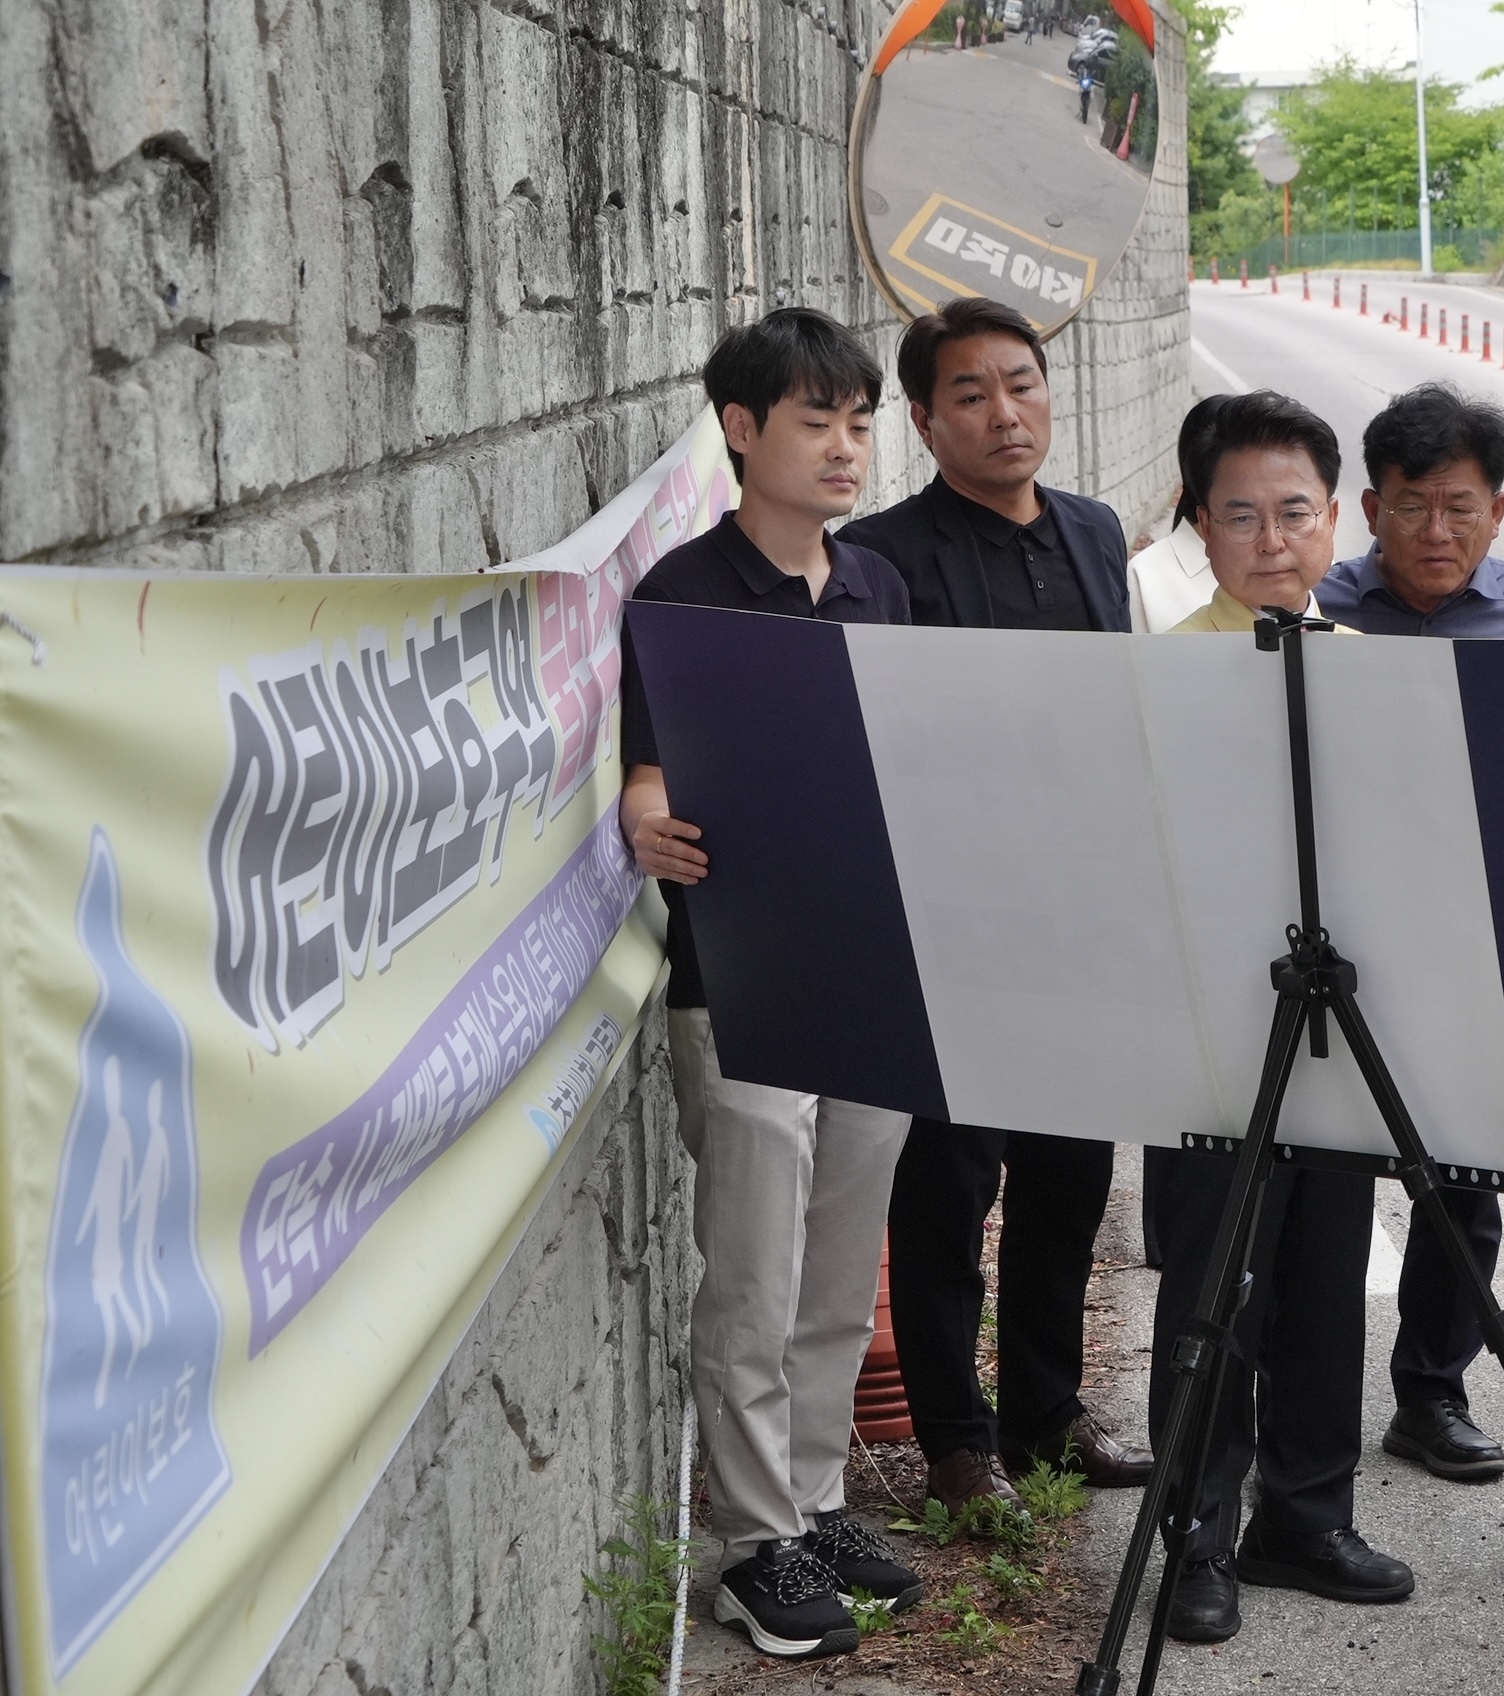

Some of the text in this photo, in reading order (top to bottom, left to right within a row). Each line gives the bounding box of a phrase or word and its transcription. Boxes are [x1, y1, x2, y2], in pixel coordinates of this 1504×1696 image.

[207, 577, 557, 1030] 어린이보호구역
[256, 1142, 334, 1322] 단속
[323, 1106, 383, 1249] 시
[355, 1043, 456, 1214] 과태료
[64, 1361, 196, 1567] 어린이보호
